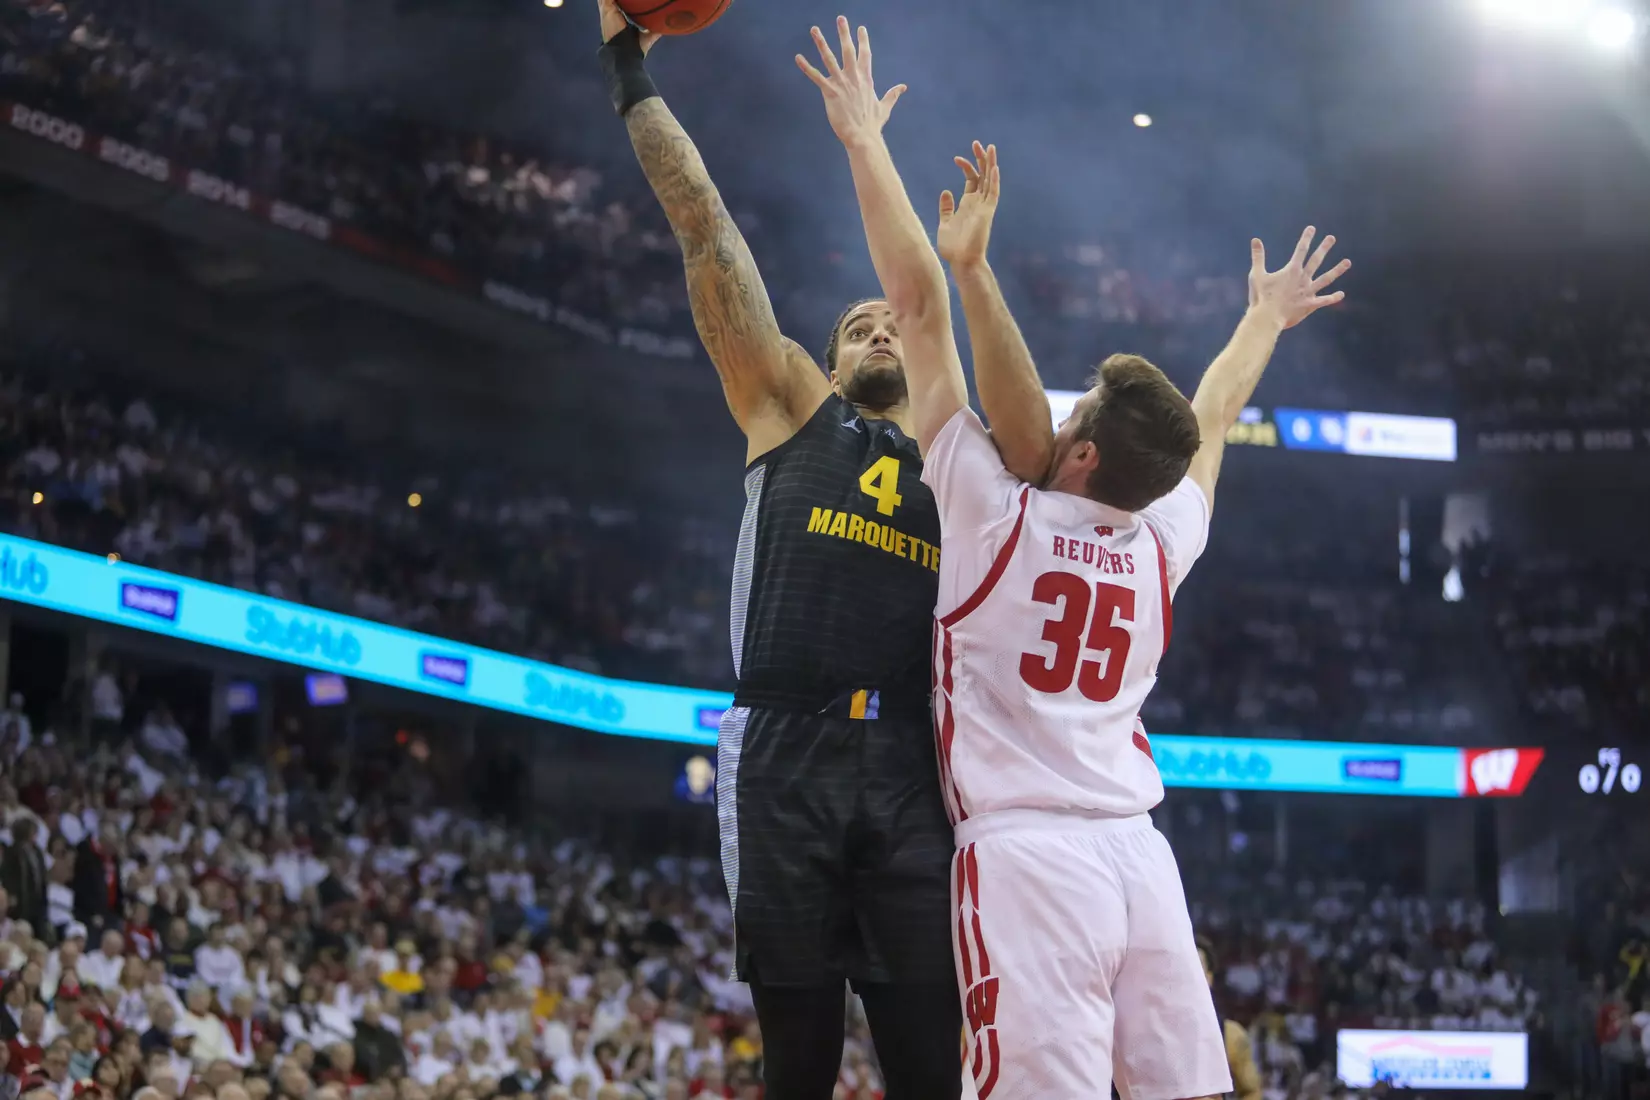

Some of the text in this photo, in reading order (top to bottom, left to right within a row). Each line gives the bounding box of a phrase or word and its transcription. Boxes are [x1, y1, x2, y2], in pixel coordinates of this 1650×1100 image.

[10, 102, 84, 150] 2000
[858, 456, 903, 517] 4
[806, 506, 941, 575] MARQUETTE
[1052, 534, 1135, 575] REUVERS
[1019, 571, 1136, 703] 35
